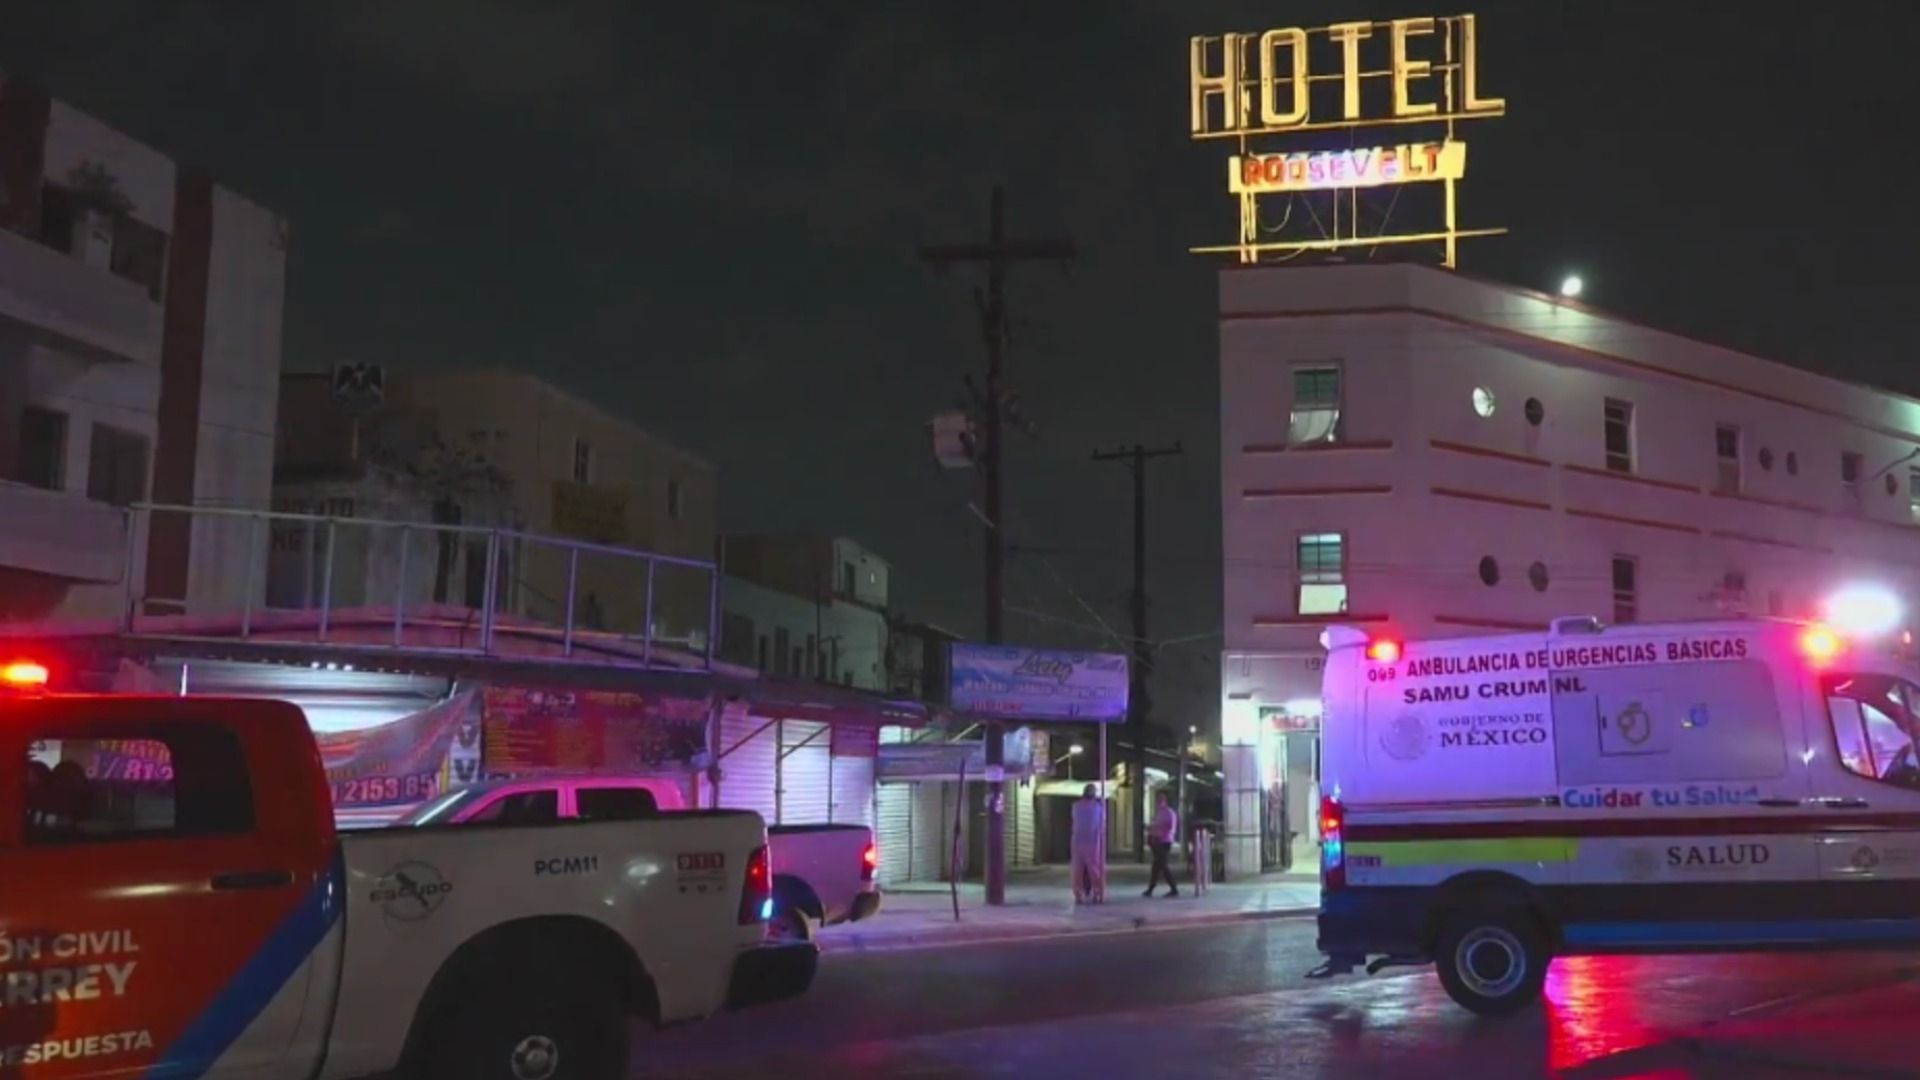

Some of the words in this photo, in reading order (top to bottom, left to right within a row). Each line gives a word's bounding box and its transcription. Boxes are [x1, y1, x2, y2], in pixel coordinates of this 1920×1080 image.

[1191, 14, 1505, 132] HOTEL
[1242, 145, 1443, 186] ROOSEVELT
[1407, 652, 1520, 678] AMBULANCIA
[1525, 649, 1548, 669] DE
[1553, 642, 1657, 667] URGENCIAS
[1667, 637, 1747, 661] BÁSICAS
[1404, 684, 1469, 704] SAMU
[1478, 679, 1548, 699] CRUM
[1555, 677, 1587, 694] NL
[1524, 712, 1544, 724] DE
[1440, 726, 1548, 748] MÉXICO
[344, 777, 399, 802] 2153
[1564, 787, 1643, 808] Cuidar
[1651, 789, 1680, 807] tu
[1685, 786, 1758, 806] Salud
[535, 855, 598, 875] PCM11
[678, 854, 723, 869] 911
[1667, 844, 1770, 867] SALUD
[52, 929, 139, 958] CIVIL
[0, 961, 138, 1006] RREY
